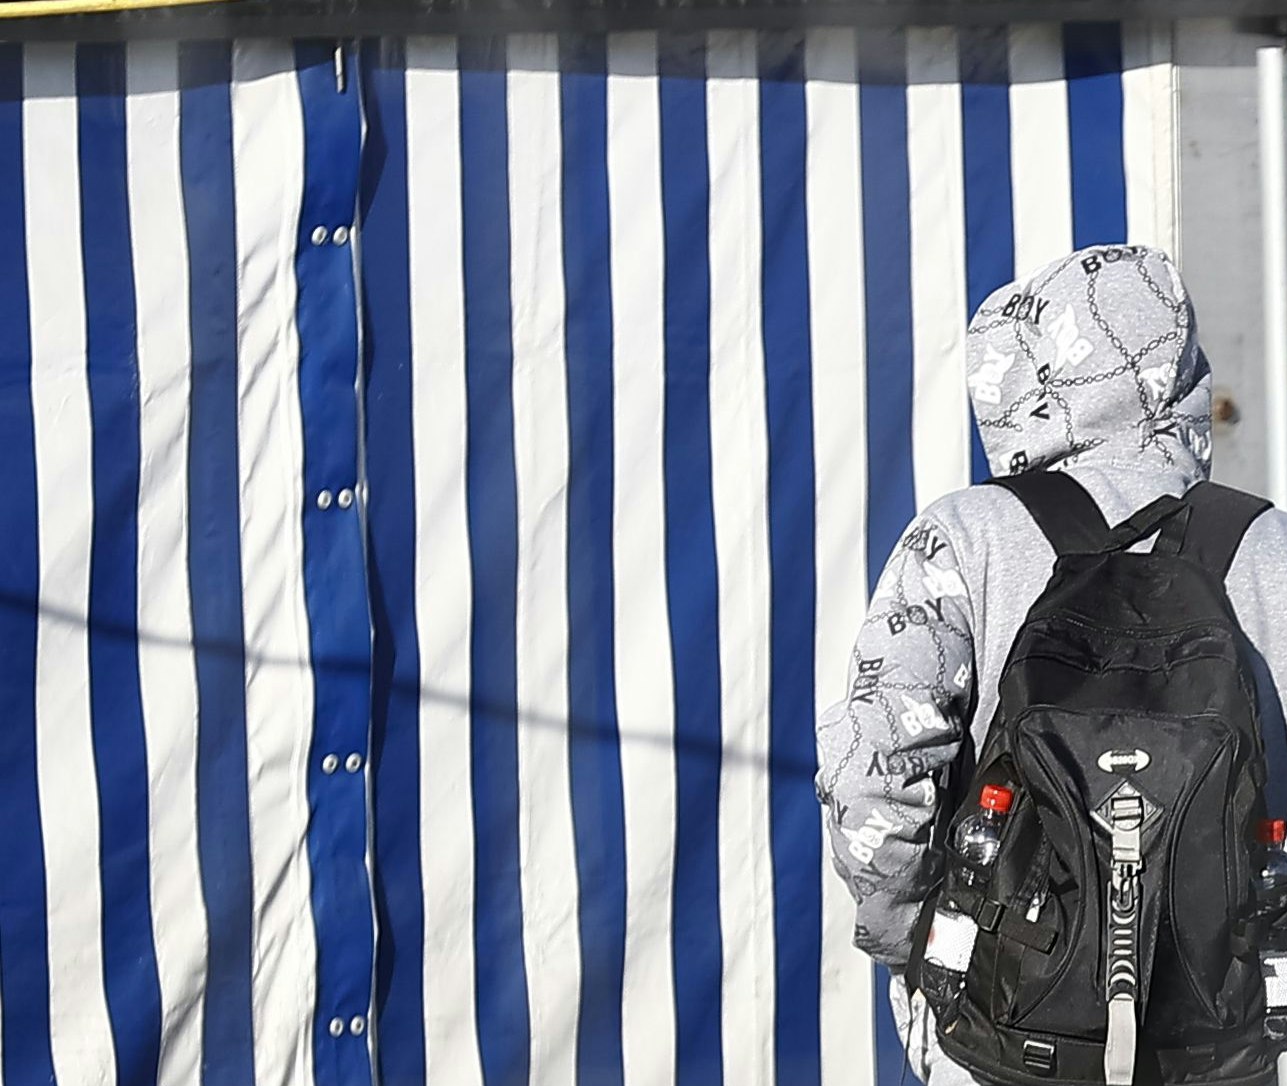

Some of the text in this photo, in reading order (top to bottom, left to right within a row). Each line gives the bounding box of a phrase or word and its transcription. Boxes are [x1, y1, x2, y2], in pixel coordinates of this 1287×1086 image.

[1002, 293, 1050, 325] BOY
[887, 597, 945, 636] BOY
[853, 656, 885, 706] BOY
[848, 808, 895, 864] BOY
